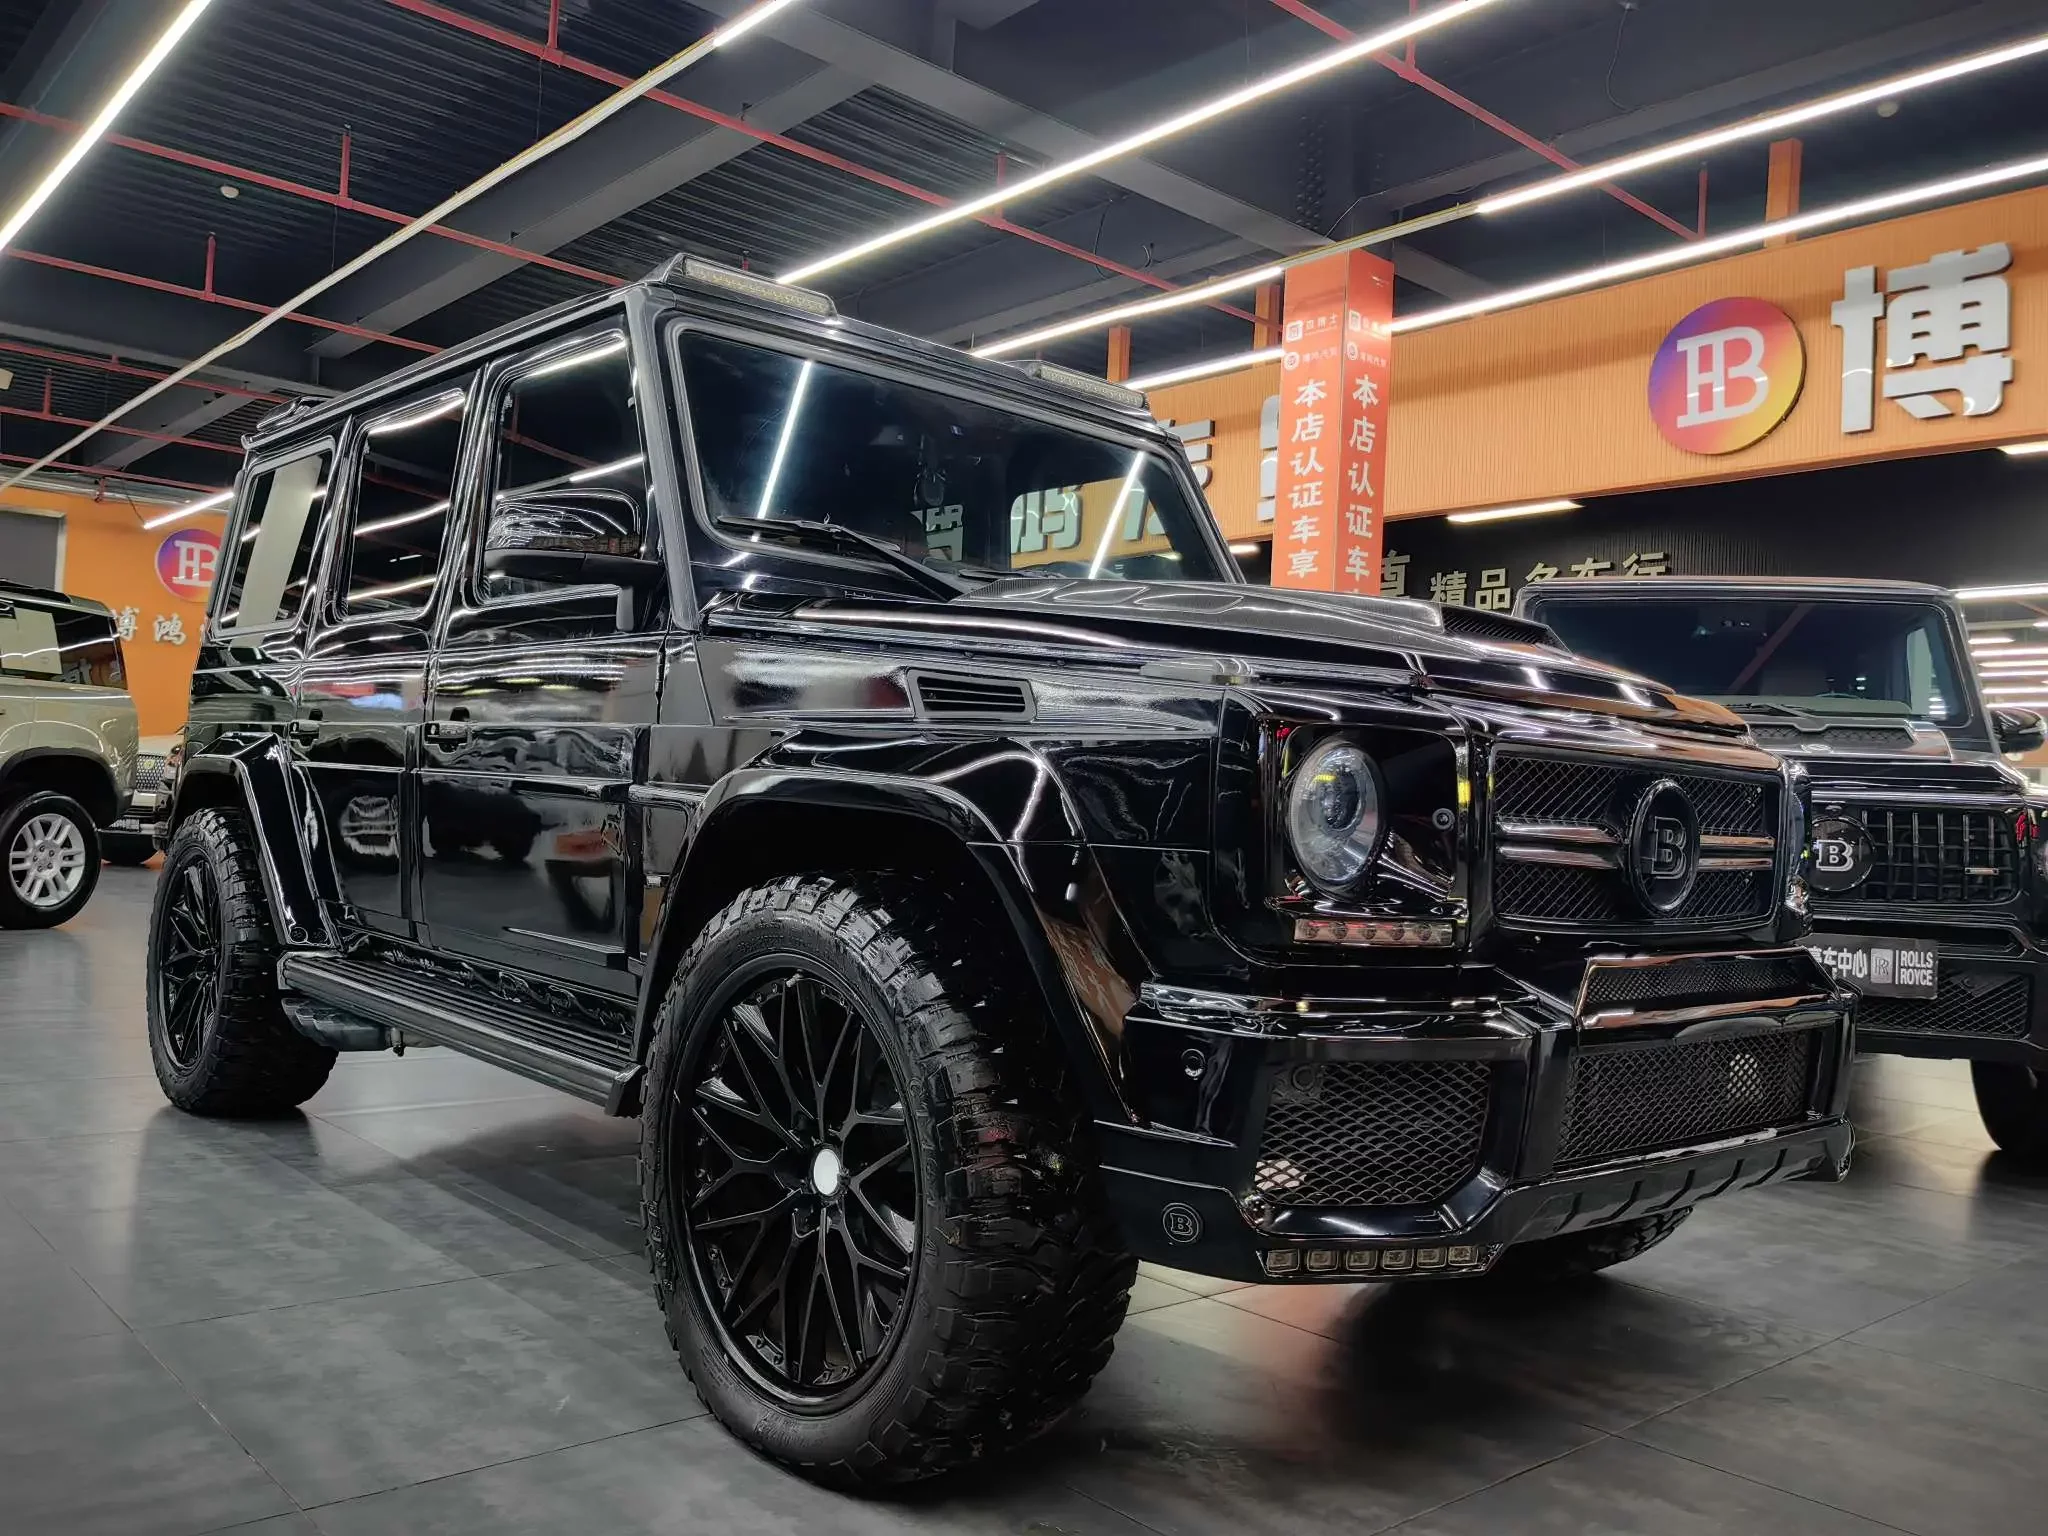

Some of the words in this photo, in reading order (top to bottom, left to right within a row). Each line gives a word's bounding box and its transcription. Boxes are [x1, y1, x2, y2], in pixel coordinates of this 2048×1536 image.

[1831, 242, 2014, 434] 博
[1287, 378, 1328, 579] 本店认证车享
[1345, 374, 1380, 590] 本店认证车
[1650, 815, 1687, 880] B
[1815, 839, 1855, 872] B
[1900, 949, 1934, 968] ROLLS
[1900, 968, 1934, 986] ROYCE
